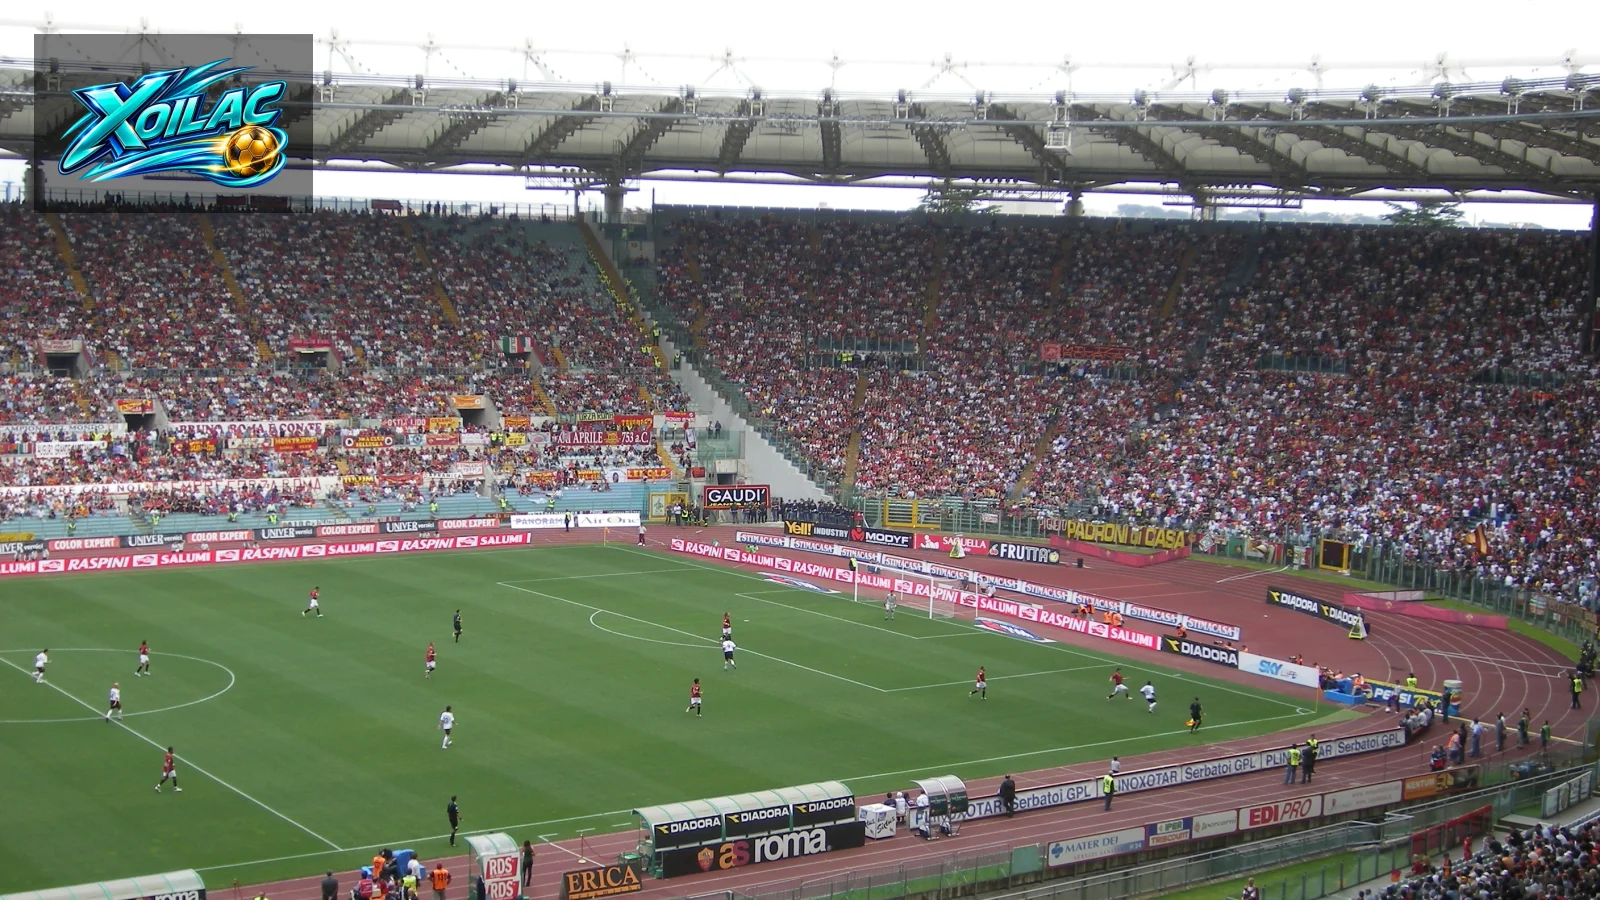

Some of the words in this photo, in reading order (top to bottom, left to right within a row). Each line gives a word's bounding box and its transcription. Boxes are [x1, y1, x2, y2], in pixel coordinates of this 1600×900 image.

[573, 432, 604, 444] APRILE
[621, 432, 634, 443] 753
[321, 525, 346, 536] COLOR
[347, 524, 375, 534] EXPERT
[386, 521, 418, 533] UNIVER
[443, 520, 466, 530] COLOR
[467, 518, 499, 529] EXPERT
[515, 518, 568, 526] PANORAM
[785, 520, 813, 536] Yell!
[813, 527, 849, 538] INDUSTRY
[128, 534, 164, 547] UNIVER
[191, 532, 217, 543] COLOR
[219, 531, 249, 542] EXPERT
[261, 528, 295, 540] UNIVER
[865, 531, 909, 544] MODYF
[1066, 519, 1128, 544] PADRONI
[1145, 527, 1185, 549] CASA
[54, 539, 84, 550] COLOR
[86, 537, 115, 549] EXPERT
[0, 563, 35, 575] LUMI
[67, 556, 130, 571] RASPINI
[160, 552, 211, 565] SALUMI
[242, 546, 300, 560] RASPINI
[328, 542, 375, 555] SALUMI
[401, 538, 455, 551] RASPINI
[479, 534, 523, 547] SALUMI
[977, 574, 1018, 590] SMACASA
[685, 541, 723, 559] RASPINI
[741, 551, 774, 567] SALUMI
[792, 561, 834, 579] RASPINI
[855, 573, 891, 589] SALUMI
[914, 583, 959, 603] RASPINI
[980, 598, 1018, 616] SALUMI
[1039, 609, 1087, 633] RASPINI
[1110, 627, 1153, 648] SALUMI
[1280, 592, 1319, 614] DIADORA
[1329, 607, 1362, 626] DIADOR
[1181, 640, 1238, 667] DIADORA
[1258, 659, 1283, 677] SKY
[1265, 744, 1333, 767] PLINAR
[1337, 738, 1380, 755] Serbatoi
[1381, 733, 1401, 748] GPL
[1113, 770, 1178, 793] INOXOTAR
[1184, 761, 1232, 780] Serbatoi
[1235, 757, 1256, 772] GPL
[808, 796, 855, 813] DIADORA
[915, 801, 1002, 825] PLOTAR
[1013, 790, 1064, 810] Serbatoi
[1066, 785, 1092, 802] GPL
[740, 807, 790, 823] DIADORA
[670, 816, 721, 834] DIADORA
[718, 841, 750, 870] as
[754, 828, 827, 863] roma
[1065, 839, 1100, 853] MATER
[1102, 836, 1119, 847] DEI
[489, 857, 513, 876] RDS
[566, 865, 640, 894] ERICA
[490, 880, 514, 900] RDS
